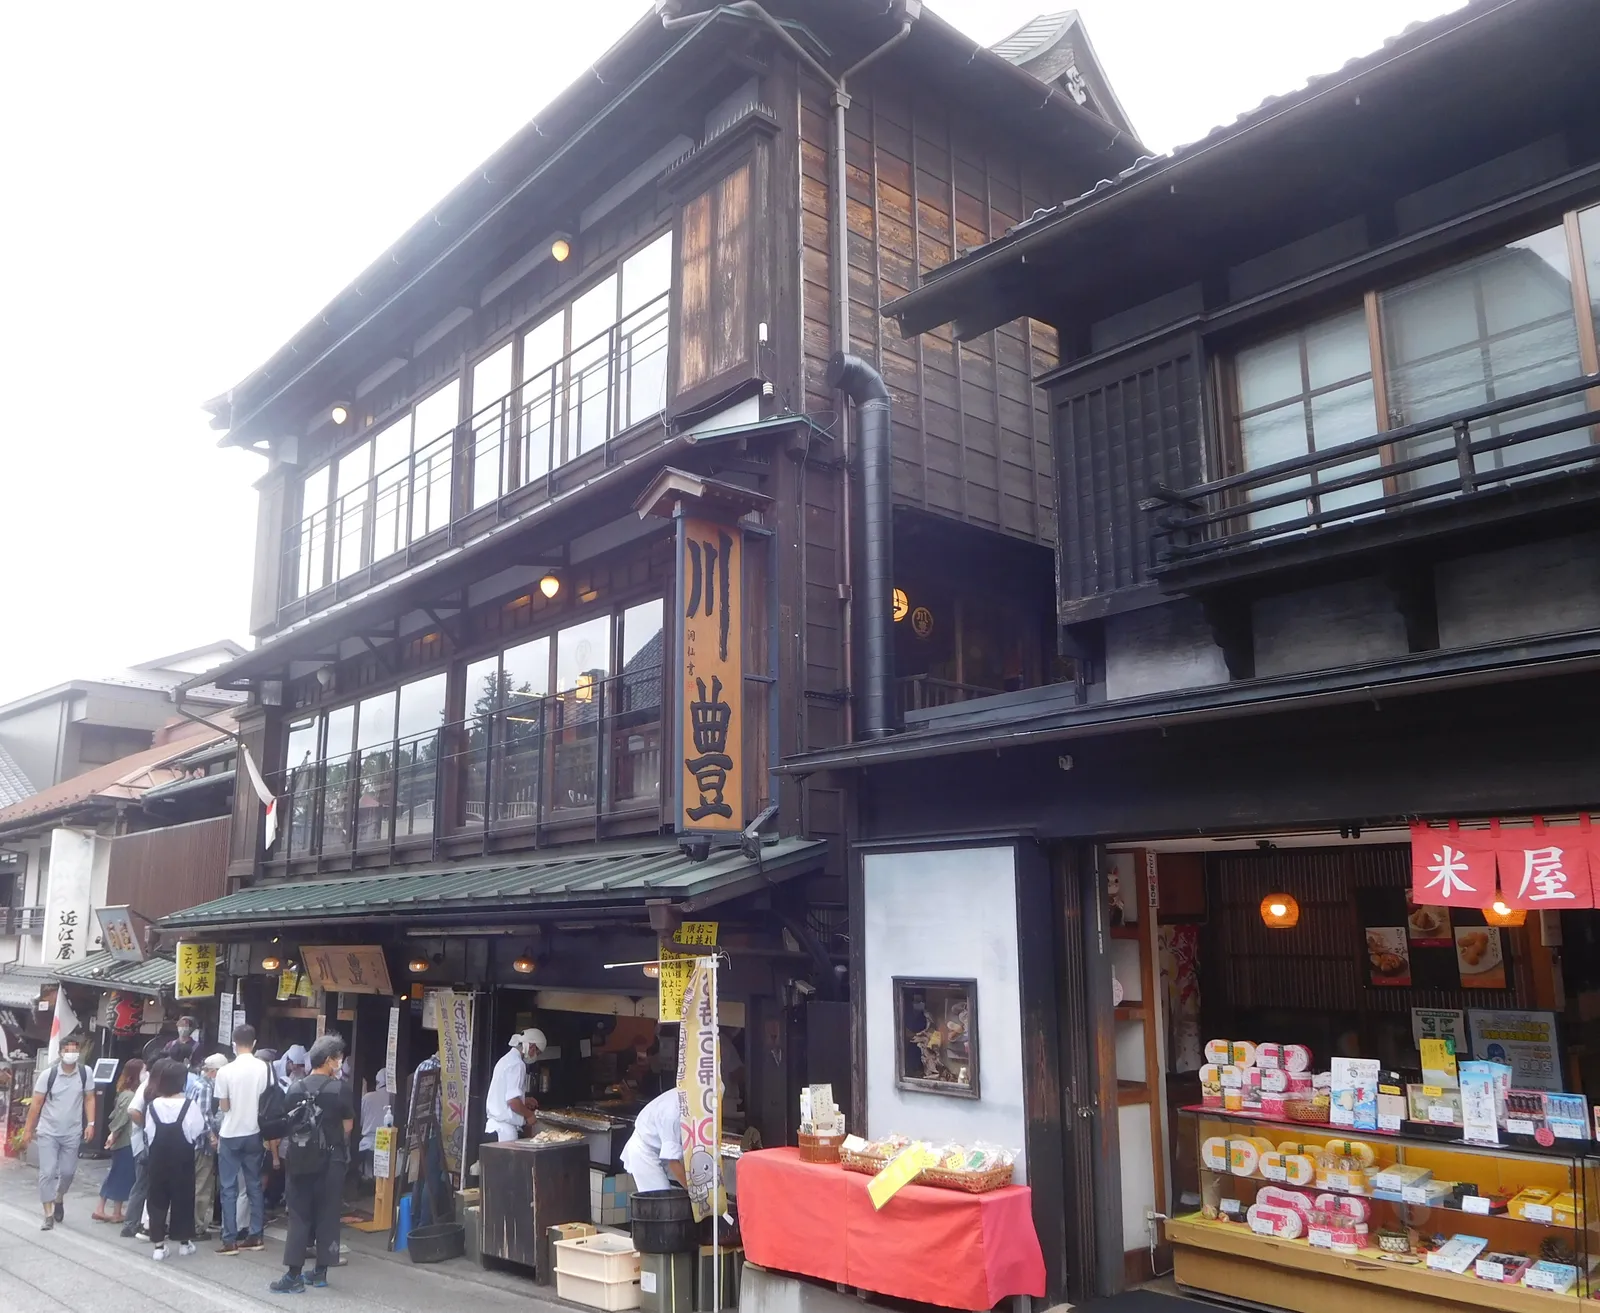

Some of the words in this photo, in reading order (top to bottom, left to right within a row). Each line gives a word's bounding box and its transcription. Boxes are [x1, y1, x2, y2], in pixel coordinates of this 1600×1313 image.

[685, 528, 733, 822] 川豊
[1424, 845, 1575, 901] 米屋
[55, 910, 78, 960] 近江屋
[184, 946, 192, 977] こちら
[194, 944, 210, 991] 整理券
